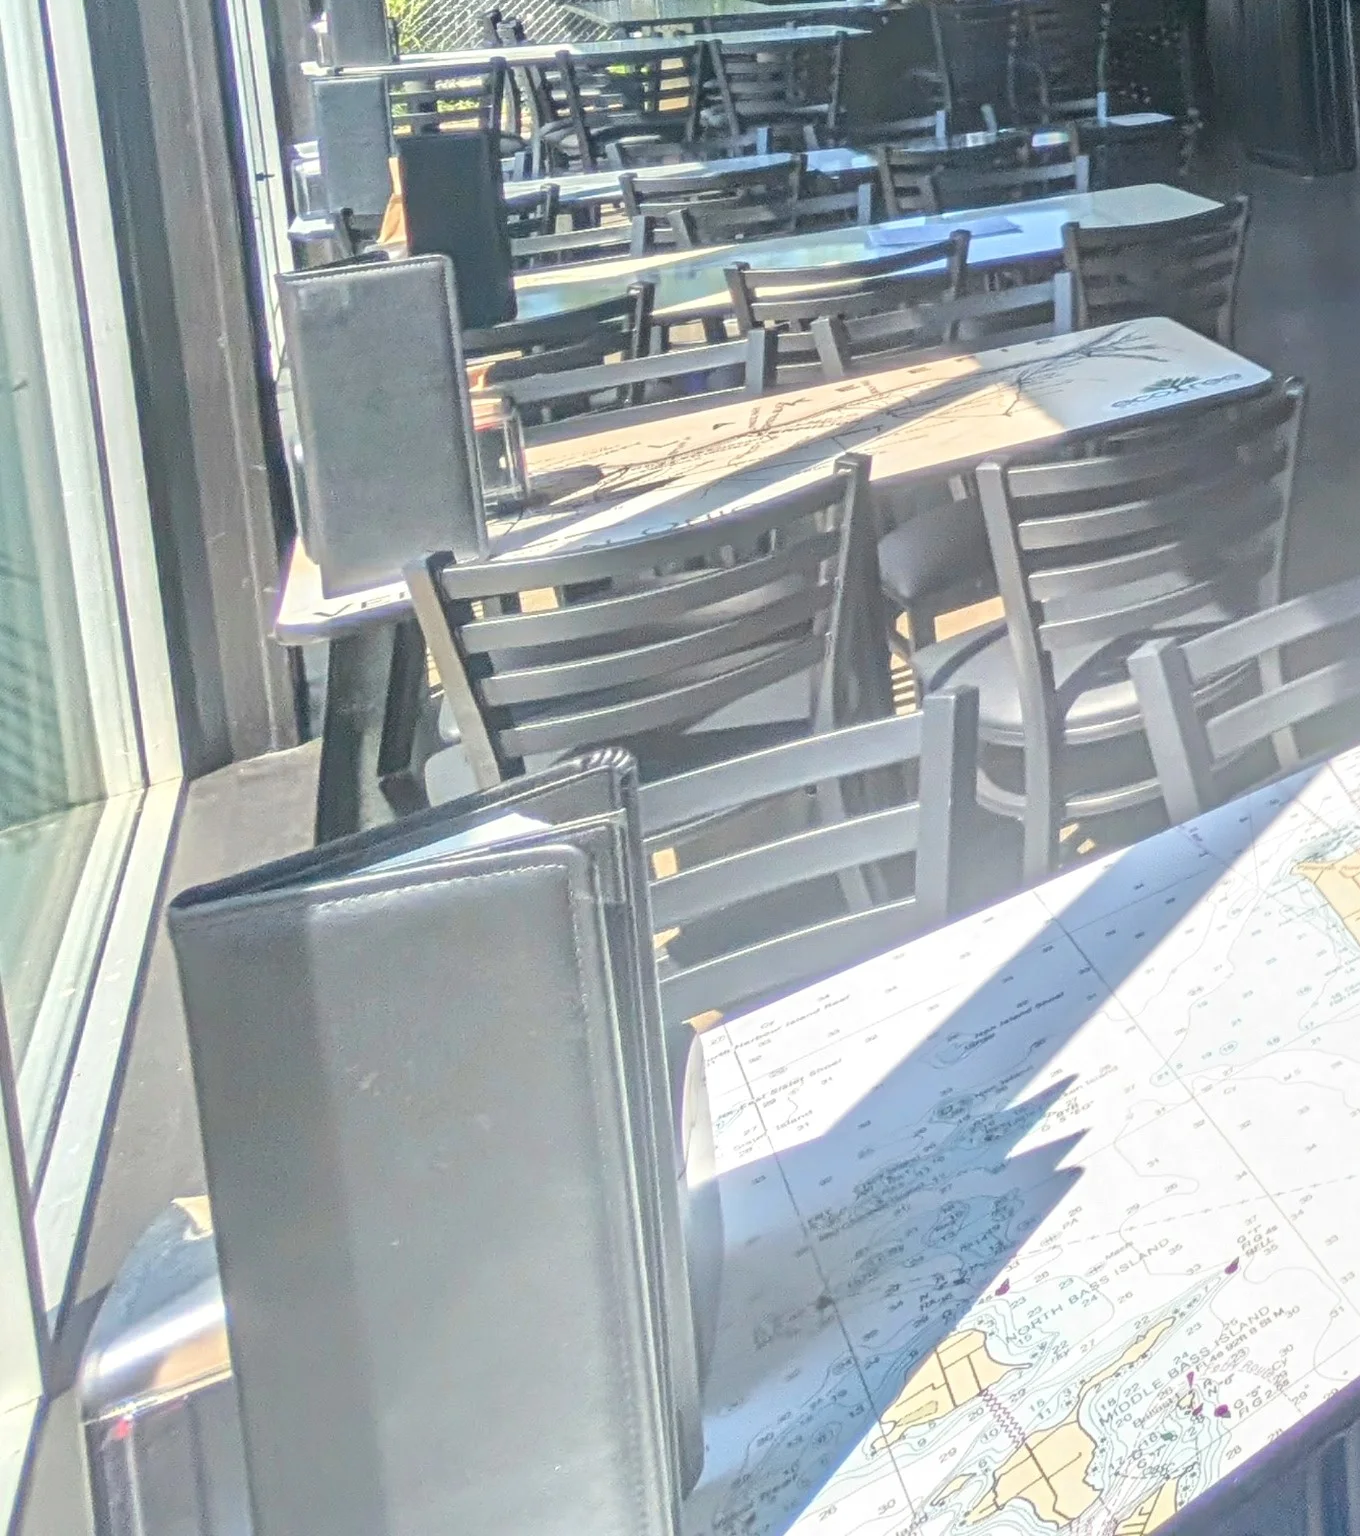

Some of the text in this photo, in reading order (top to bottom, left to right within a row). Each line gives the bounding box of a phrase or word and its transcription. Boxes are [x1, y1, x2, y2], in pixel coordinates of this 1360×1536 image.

[1005, 1237, 1170, 1343] NORTH BASS ISLAND
[1098, 1377, 1162, 1427] MIDDLE
[1167, 1347, 1211, 1380] BASS
[1214, 1306, 1270, 1347] ISLAND
[1123, 1382, 1140, 1397] 22
[1115, 1413, 1133, 1428] 20
[878, 1499, 896, 1515] 30
